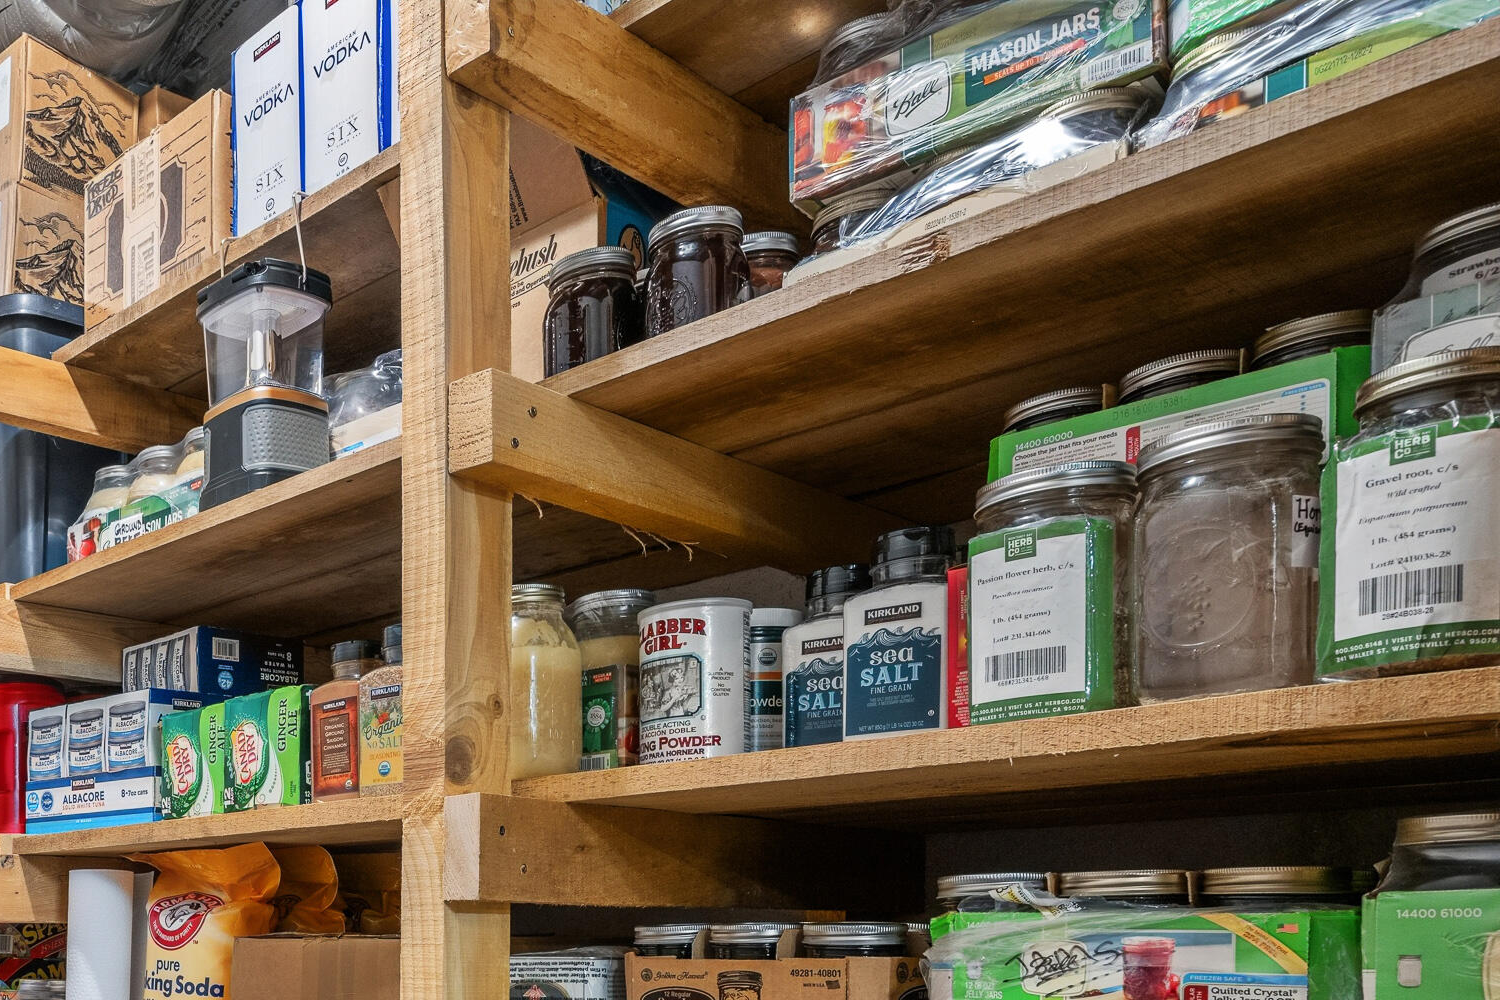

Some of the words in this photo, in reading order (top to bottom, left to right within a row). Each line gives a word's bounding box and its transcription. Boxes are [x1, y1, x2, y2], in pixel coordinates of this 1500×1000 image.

[327, 30, 357, 53] AMERICAN
[971, 30, 1042, 75] MASON
[1045, 8, 1099, 45] JARS
[313, 31, 371, 78] VODKA
[255, 82, 282, 104] AMERICAN
[893, 78, 940, 120] Ball
[244, 83, 294, 127] VODKA
[327, 117, 358, 148] SIX
[256, 164, 284, 193] SIX
[1014, 437, 1042, 452] 14400
[1043, 431, 1073, 446] 60000
[1394, 436, 1430, 450] HERB
[1365, 474, 1402, 489] Gravel
[1405, 468, 1433, 482] root,
[1437, 463, 1459, 474] c/s
[114, 520, 142, 536] GROUND
[1008, 537, 1032, 549] HERB
[977, 574, 1003, 586] Passion
[1005, 569, 1031, 580] flower
[1058, 561, 1074, 570] c/s
[867, 604, 920, 619] KIRKLAND
[640, 618, 707, 645] LABBER
[644, 635, 683, 655] GIRL
[805, 638, 844, 650] KIRKLAN
[869, 647, 915, 666] sea
[260, 672, 299, 684] ALBACORE
[860, 661, 923, 687] SALT
[371, 686, 399, 696] KIRKLAND
[870, 686, 886, 695] FINE
[888, 683, 912, 692] GRAIN
[174, 700, 201, 709] KIRKLAND
[323, 701, 346, 710] KIRKLAND
[278, 699, 288, 751] GINGER
[288, 710, 297, 737] ALE
[324, 722, 345, 731] ORGANIC
[662, 720, 691, 729] ACTING
[669, 726, 697, 735] DOBLE
[208, 714, 217, 764] GINGER
[324, 729, 345, 738] GROUND
[326, 736, 344, 744] SAIGON
[246, 734, 258, 763] DRY
[324, 743, 347, 751] CINNAMON
[659, 735, 722, 751] POWDER
[649, 752, 665, 760] PARA
[666, 748, 705, 757] HORNEAR
[72, 779, 94, 787] KIRKLAND
[62, 791, 105, 805] ALBACORE
[1396, 909, 1437, 918] 14400
[1440, 908, 1482, 918] 61000
[156, 959, 181, 972] pure
[790, 968, 841, 979] 49281-40801
[1223, 975, 1243, 983] SAFE
[145, 972, 173, 998] king
[176, 976, 225, 998] Soda
[1210, 986, 1250, 997] Quilted
